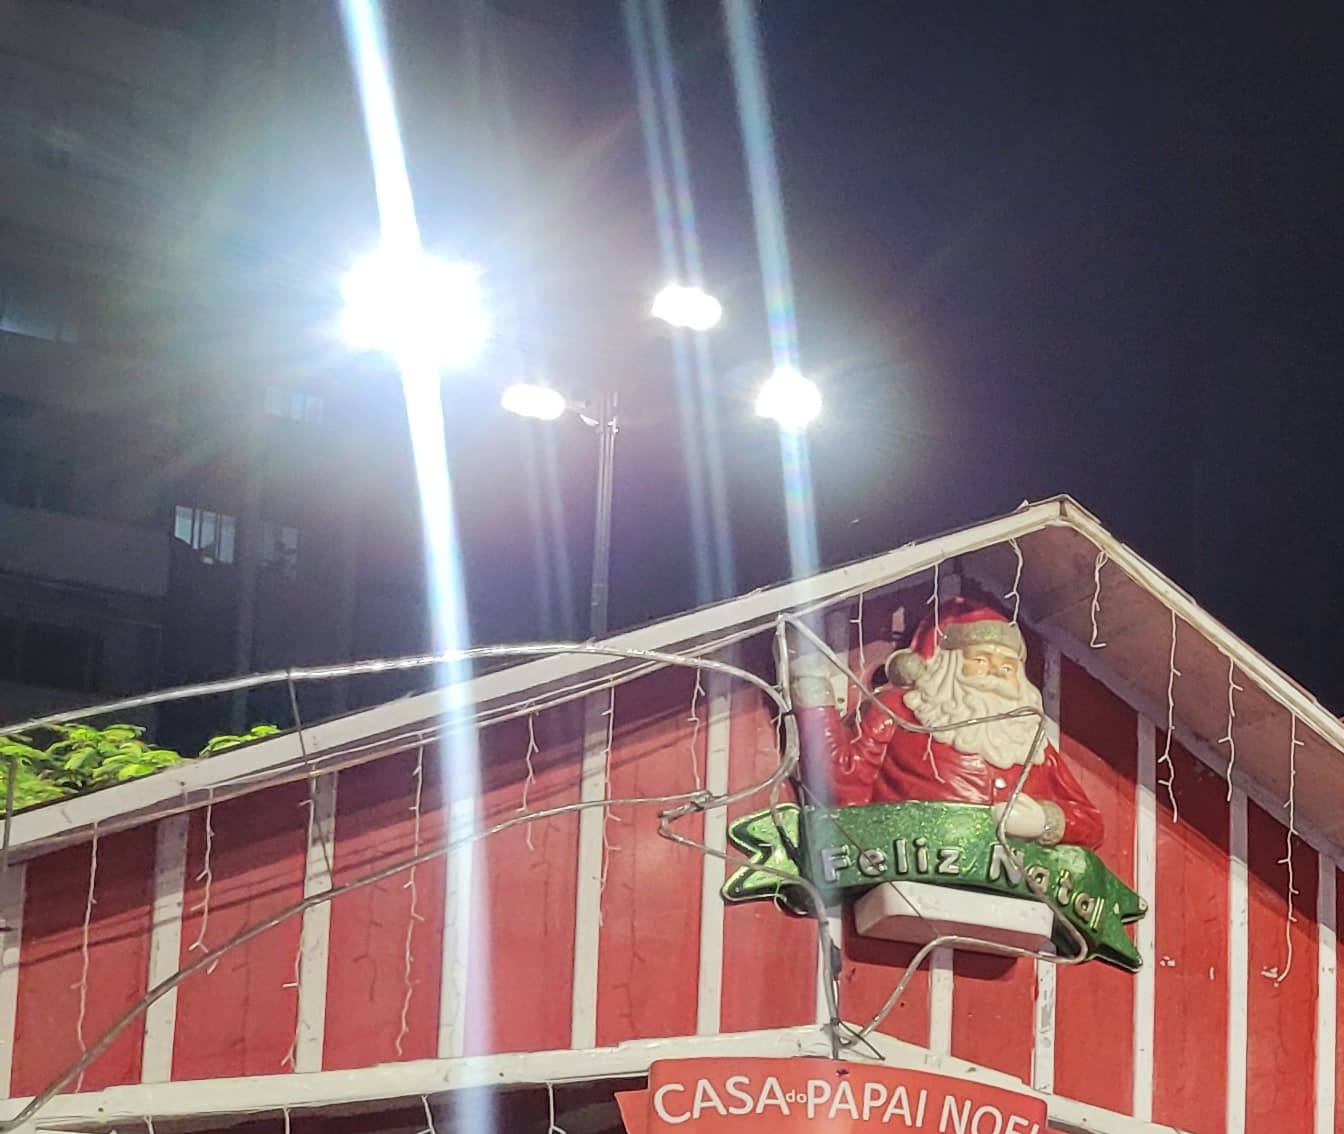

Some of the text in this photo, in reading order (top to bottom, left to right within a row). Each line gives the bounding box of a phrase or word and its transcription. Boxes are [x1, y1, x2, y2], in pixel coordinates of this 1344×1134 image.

[820, 836, 1105, 932] Feliz Natal
[652, 1074, 791, 1125] CASA
[785, 1088, 807, 1104] do
[806, 1079, 928, 1128] PAPAI
